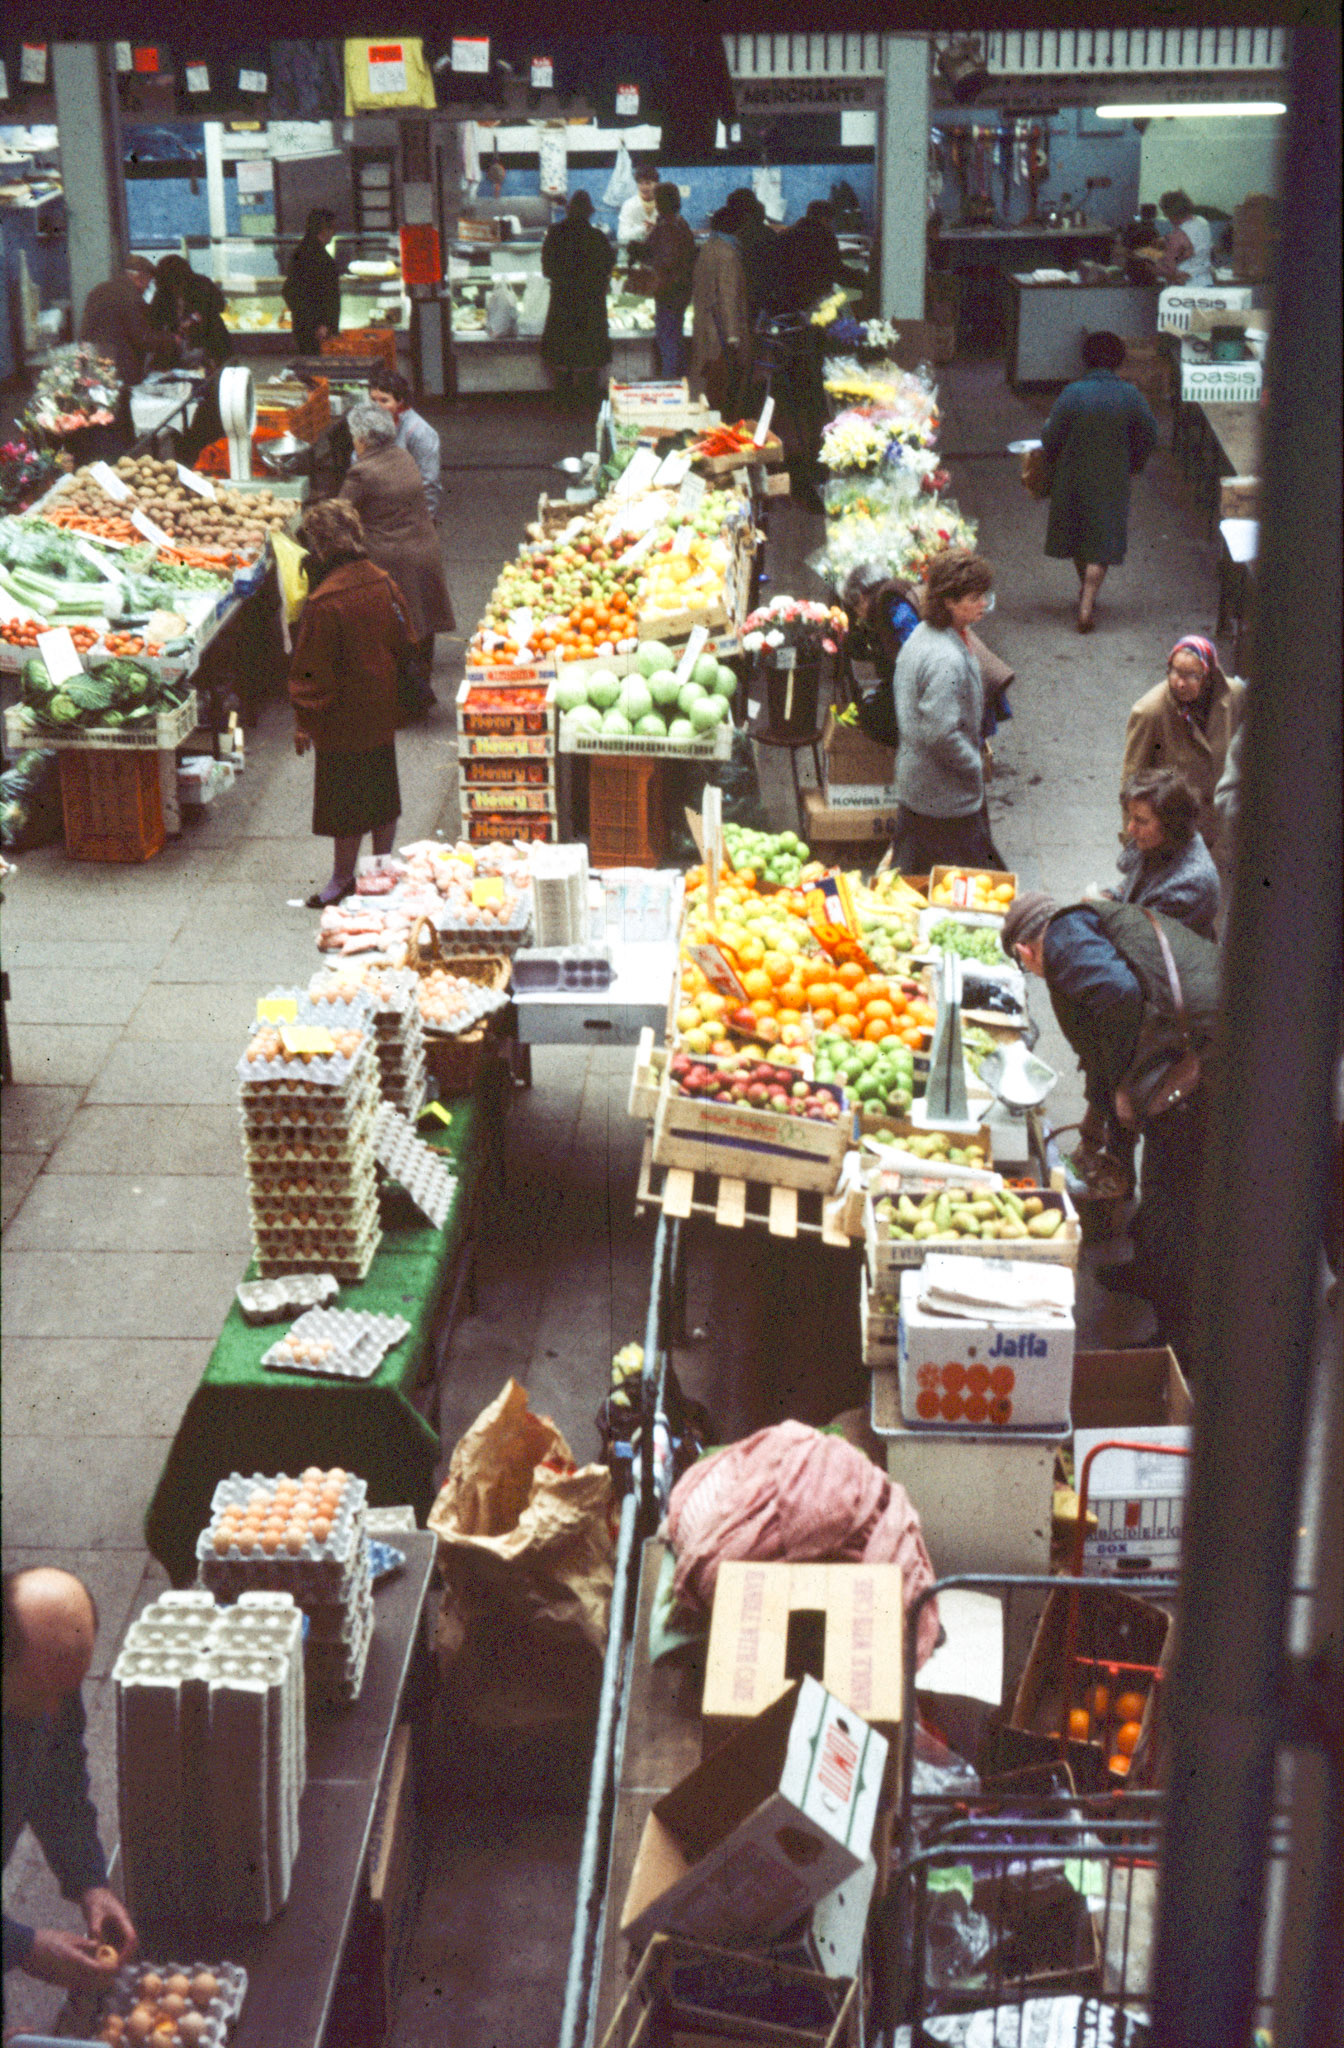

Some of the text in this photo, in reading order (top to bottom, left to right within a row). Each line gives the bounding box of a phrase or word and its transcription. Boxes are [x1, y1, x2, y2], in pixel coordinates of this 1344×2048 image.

[744, 86, 865, 103] MERCHANTS
[1168, 297, 1226, 310] oasis
[1191, 372, 1256, 384] oasis
[470, 713, 525, 733] Henry
[476, 736, 529, 757] Henry
[471, 763, 526, 783] Henry
[475, 792, 527, 810] Henry
[832, 796, 880, 806] FLOWERS
[475, 820, 530, 842] Henry
[988, 1332, 1048, 1359] Jaffa
